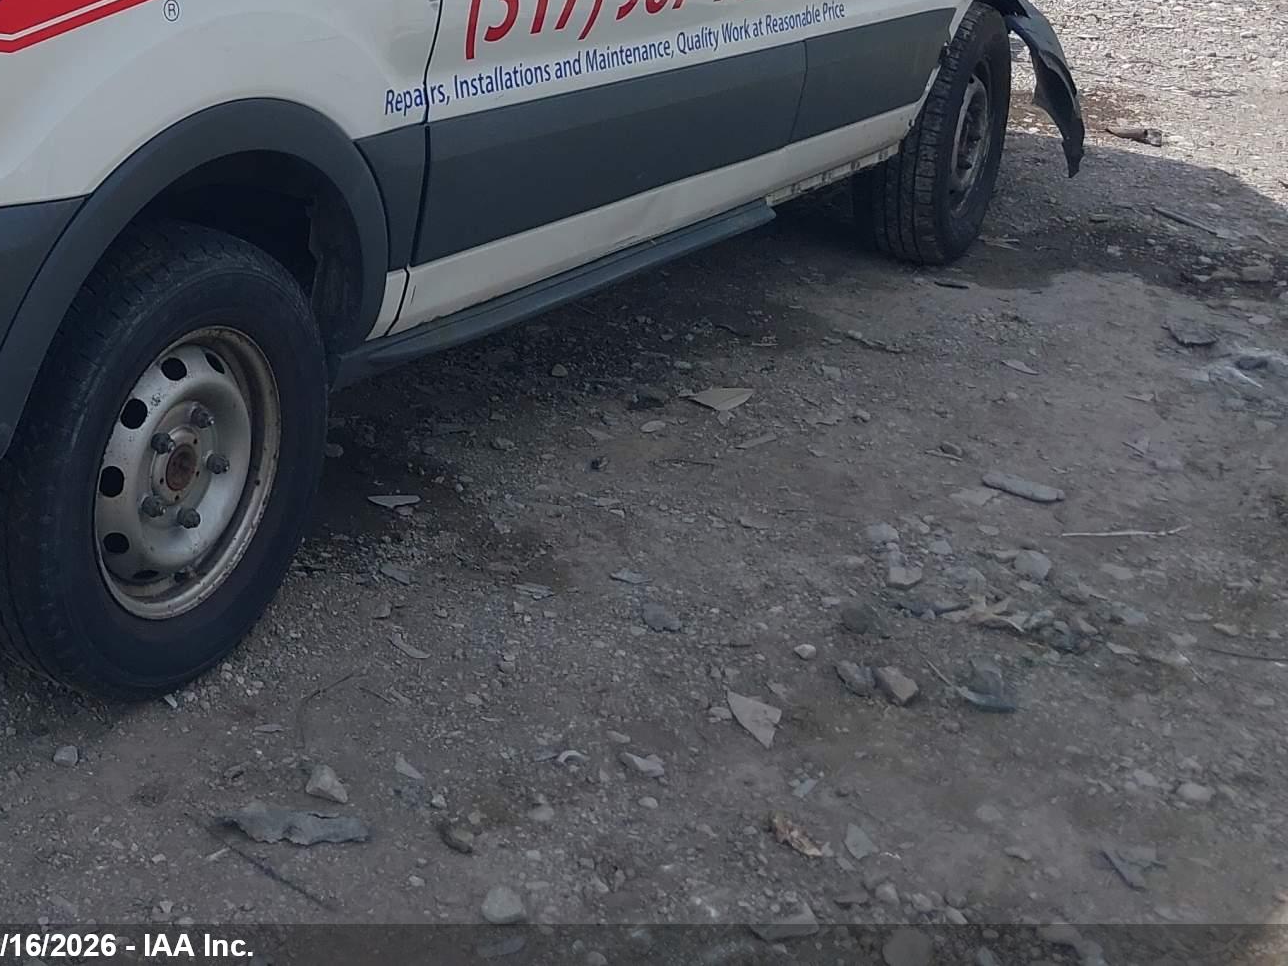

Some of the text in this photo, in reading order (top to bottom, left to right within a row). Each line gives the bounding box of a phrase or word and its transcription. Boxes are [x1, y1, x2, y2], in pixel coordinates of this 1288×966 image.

[384, 0, 845, 116] Repairs, Installations and Maintenance, Quality Work at Reasonable Price
